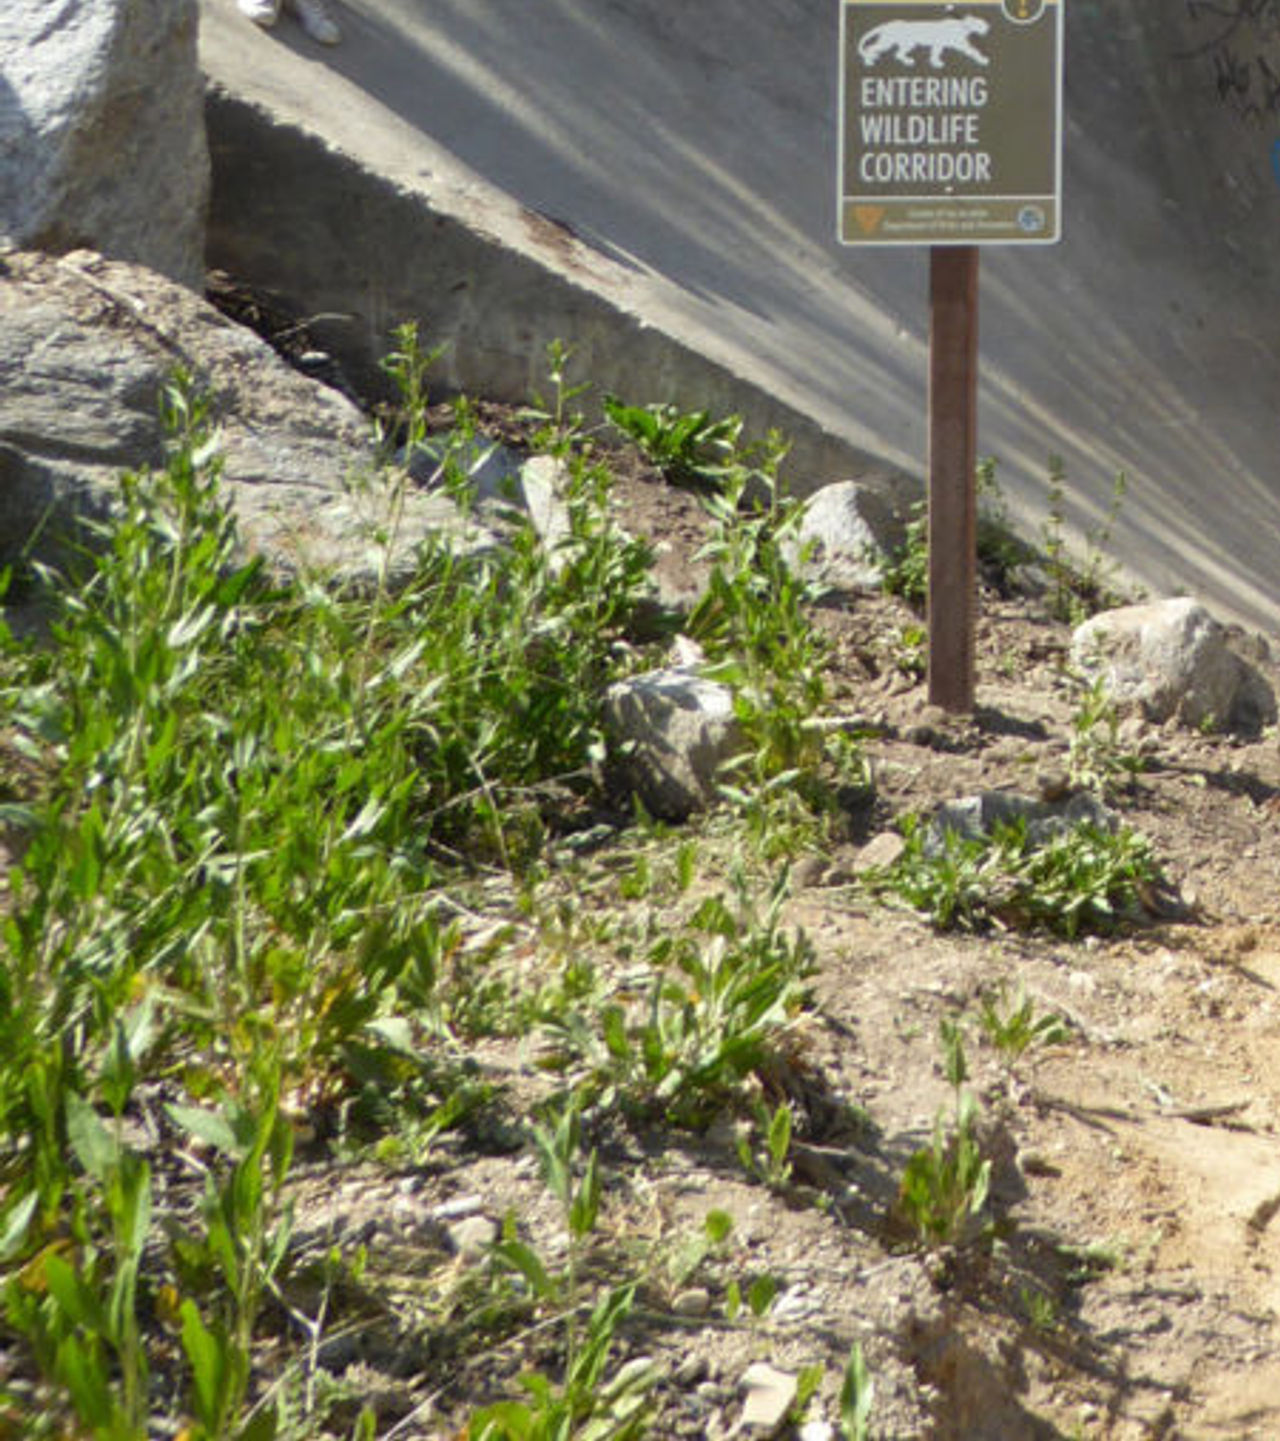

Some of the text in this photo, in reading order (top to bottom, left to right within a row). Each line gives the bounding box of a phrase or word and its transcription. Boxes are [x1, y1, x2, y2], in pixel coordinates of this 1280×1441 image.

[861, 77, 988, 106] ENTERING
[860, 114, 980, 144] WILDLIFE
[860, 152, 992, 182] CORRIDOR
